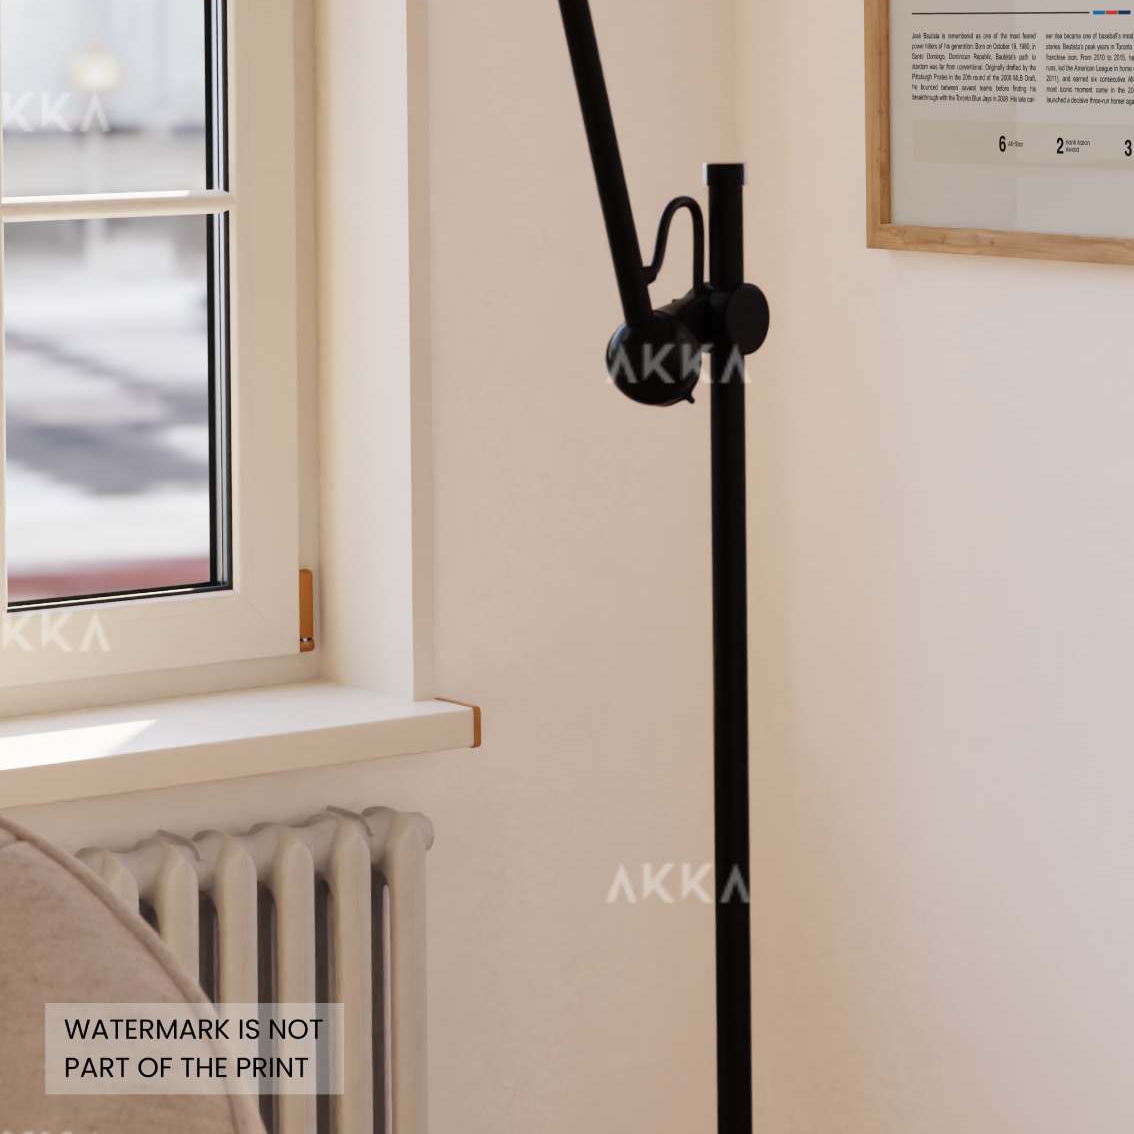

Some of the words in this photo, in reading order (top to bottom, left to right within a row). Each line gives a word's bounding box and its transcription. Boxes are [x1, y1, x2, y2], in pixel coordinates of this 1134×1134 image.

[999, 135, 1007, 153] 6
[1056, 137, 1065, 154] 2
[1124, 139, 1132, 157] 3
